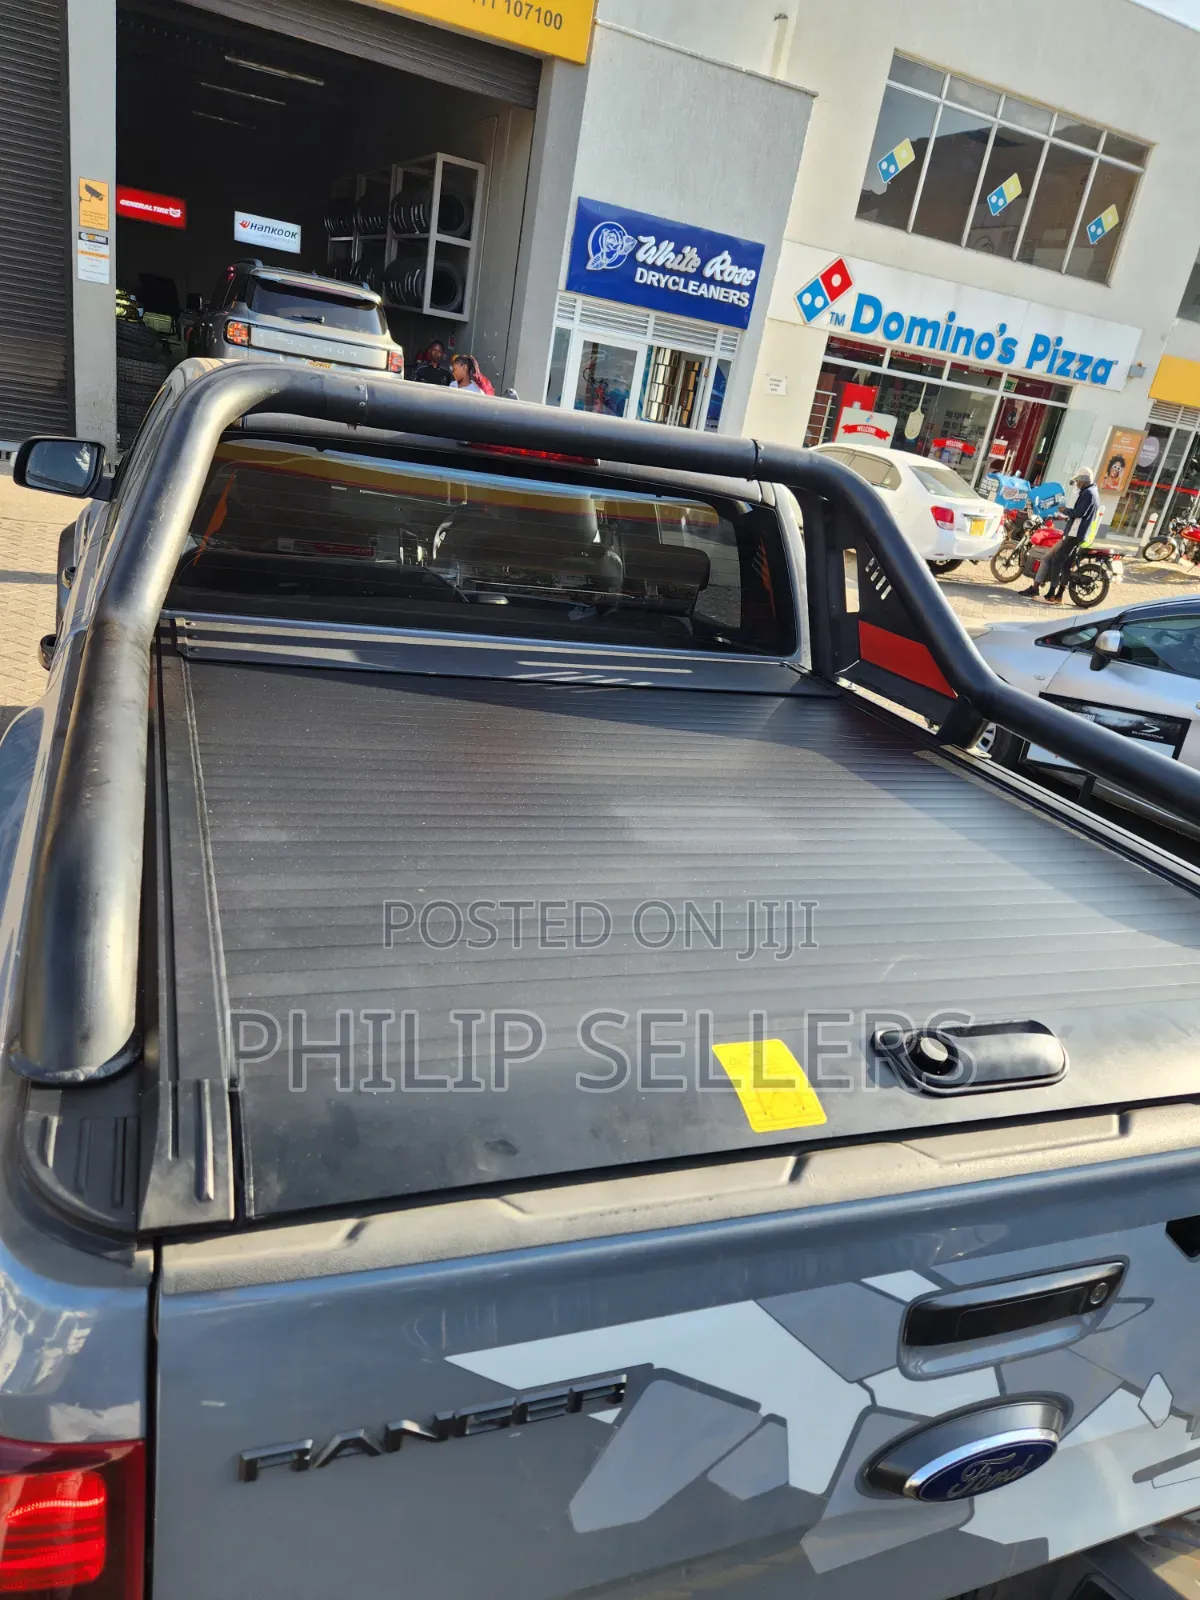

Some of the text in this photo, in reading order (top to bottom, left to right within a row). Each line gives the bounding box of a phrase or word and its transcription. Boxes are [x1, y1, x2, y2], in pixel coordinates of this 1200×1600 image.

[505, 0, 563, 31] 107100
[636, 235, 757, 287] White Rose
[634, 267, 751, 308] DRYCLEANERS
[849, 292, 1019, 366] Domino's
[1025, 332, 1114, 386] Pizza
[946, 1451, 1034, 1498] Ford
